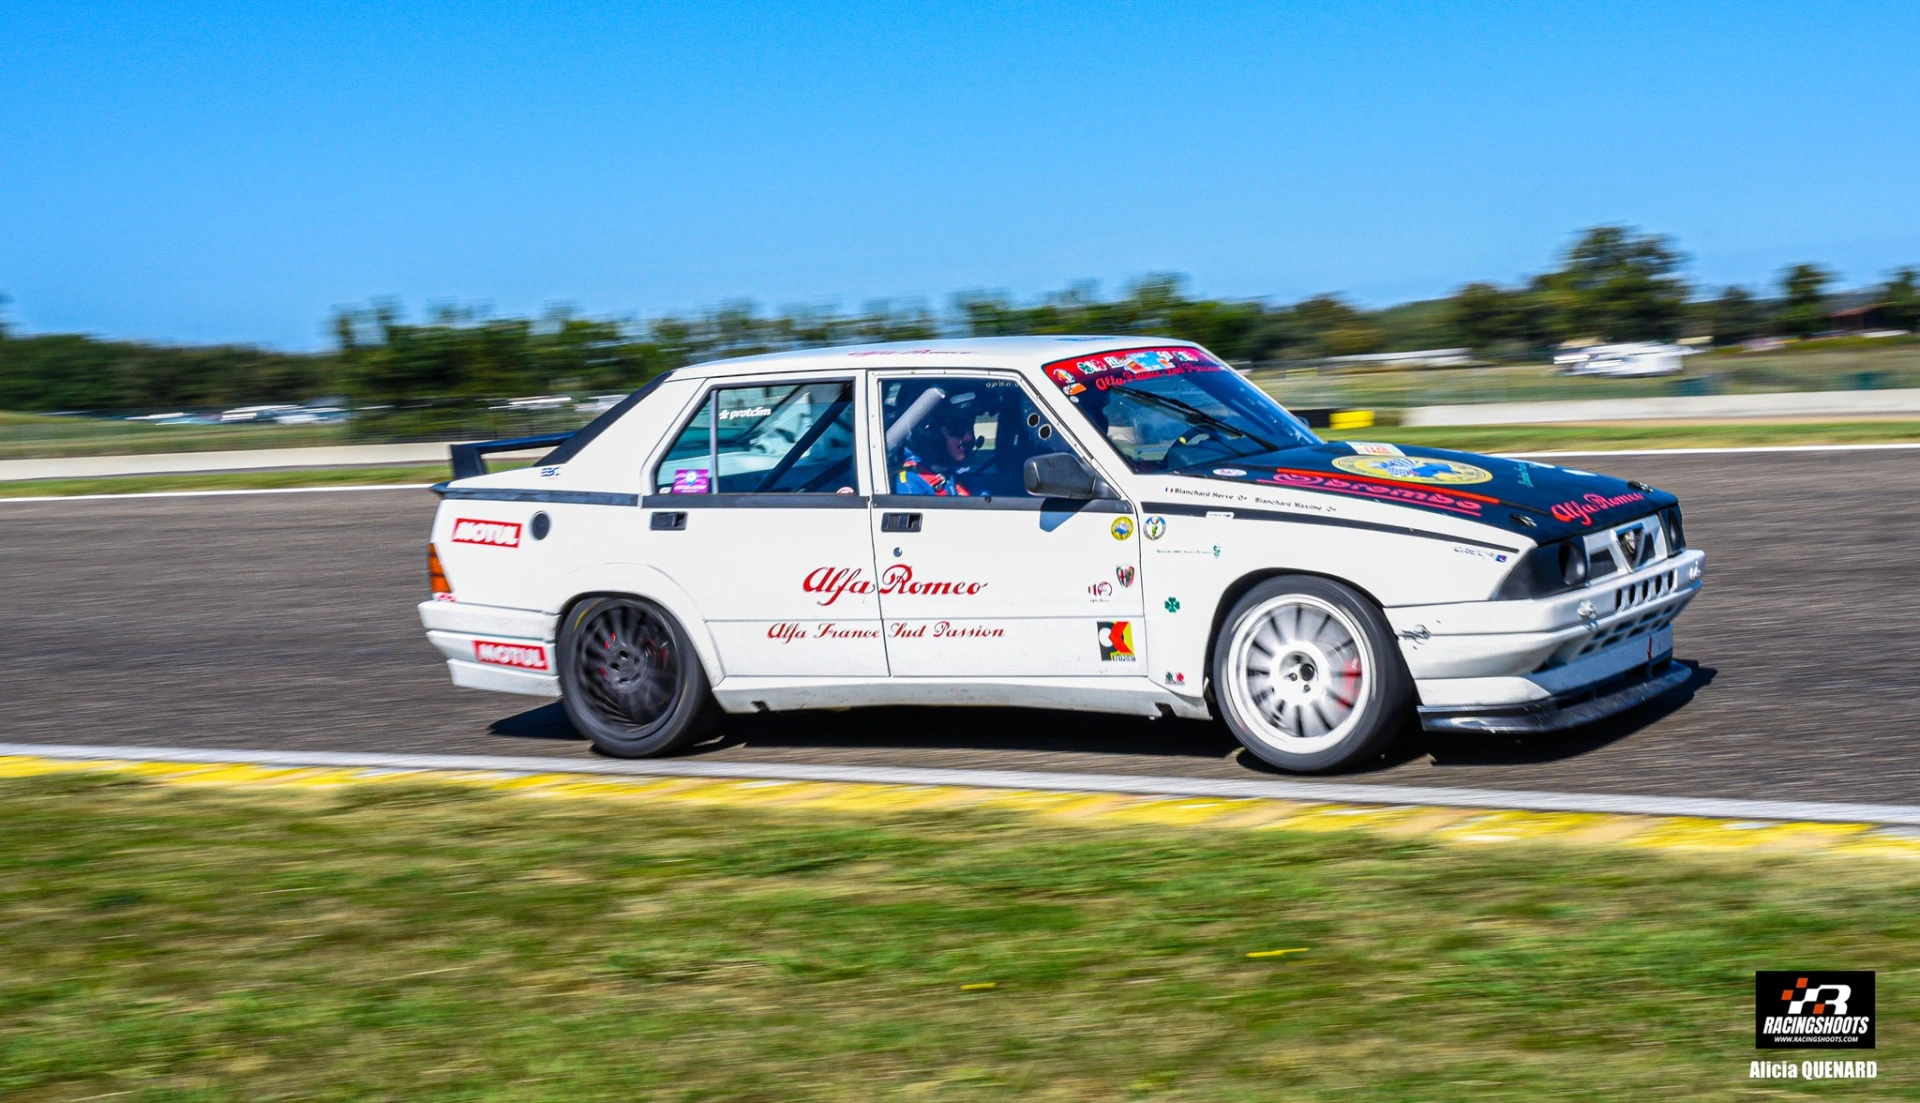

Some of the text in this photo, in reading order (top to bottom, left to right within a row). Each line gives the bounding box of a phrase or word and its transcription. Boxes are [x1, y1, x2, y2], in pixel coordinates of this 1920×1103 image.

[1323, 478, 1483, 511] brembo
[1551, 493, 1645, 526] Alfa Romeo
[453, 521, 520, 545] MOTUL
[802, 564, 988, 606] Alfa Romeo
[767, 620, 1005, 644] Alfa France Sud Passion
[478, 643, 546, 667] MOTUL
